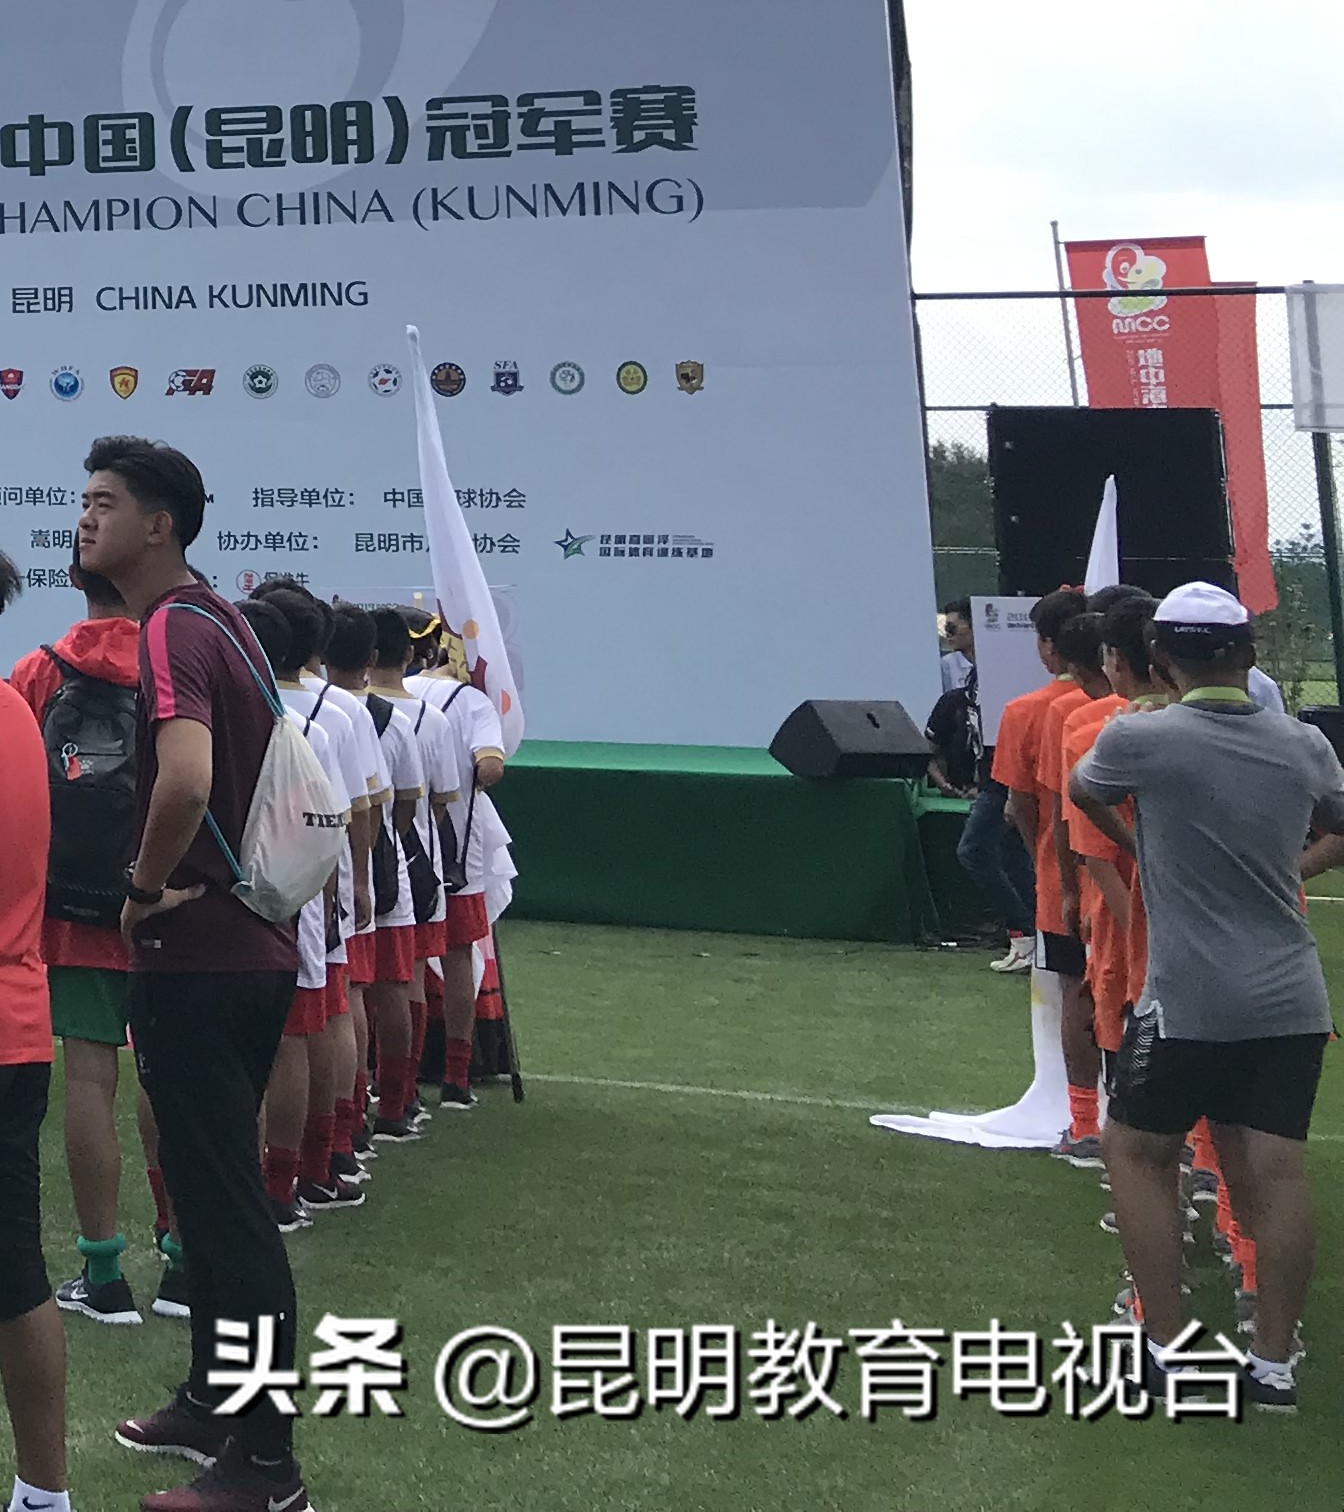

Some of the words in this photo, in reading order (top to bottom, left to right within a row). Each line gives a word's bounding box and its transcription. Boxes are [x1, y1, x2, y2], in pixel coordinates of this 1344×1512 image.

[237, 188, 394, 227] CHINA
[412, 177, 705, 232] (KUNMING)
[96, 285, 198, 311] CHINA
[209, 280, 369, 309] KUNMING
[1113, 316, 1171, 334] MCC
[252, 487, 355, 509] 指导单位：
[383, 488, 527, 510] 中国球协会
[217, 531, 319, 553] 协办单位：
[355, 532, 521, 554] 昆明市协会
